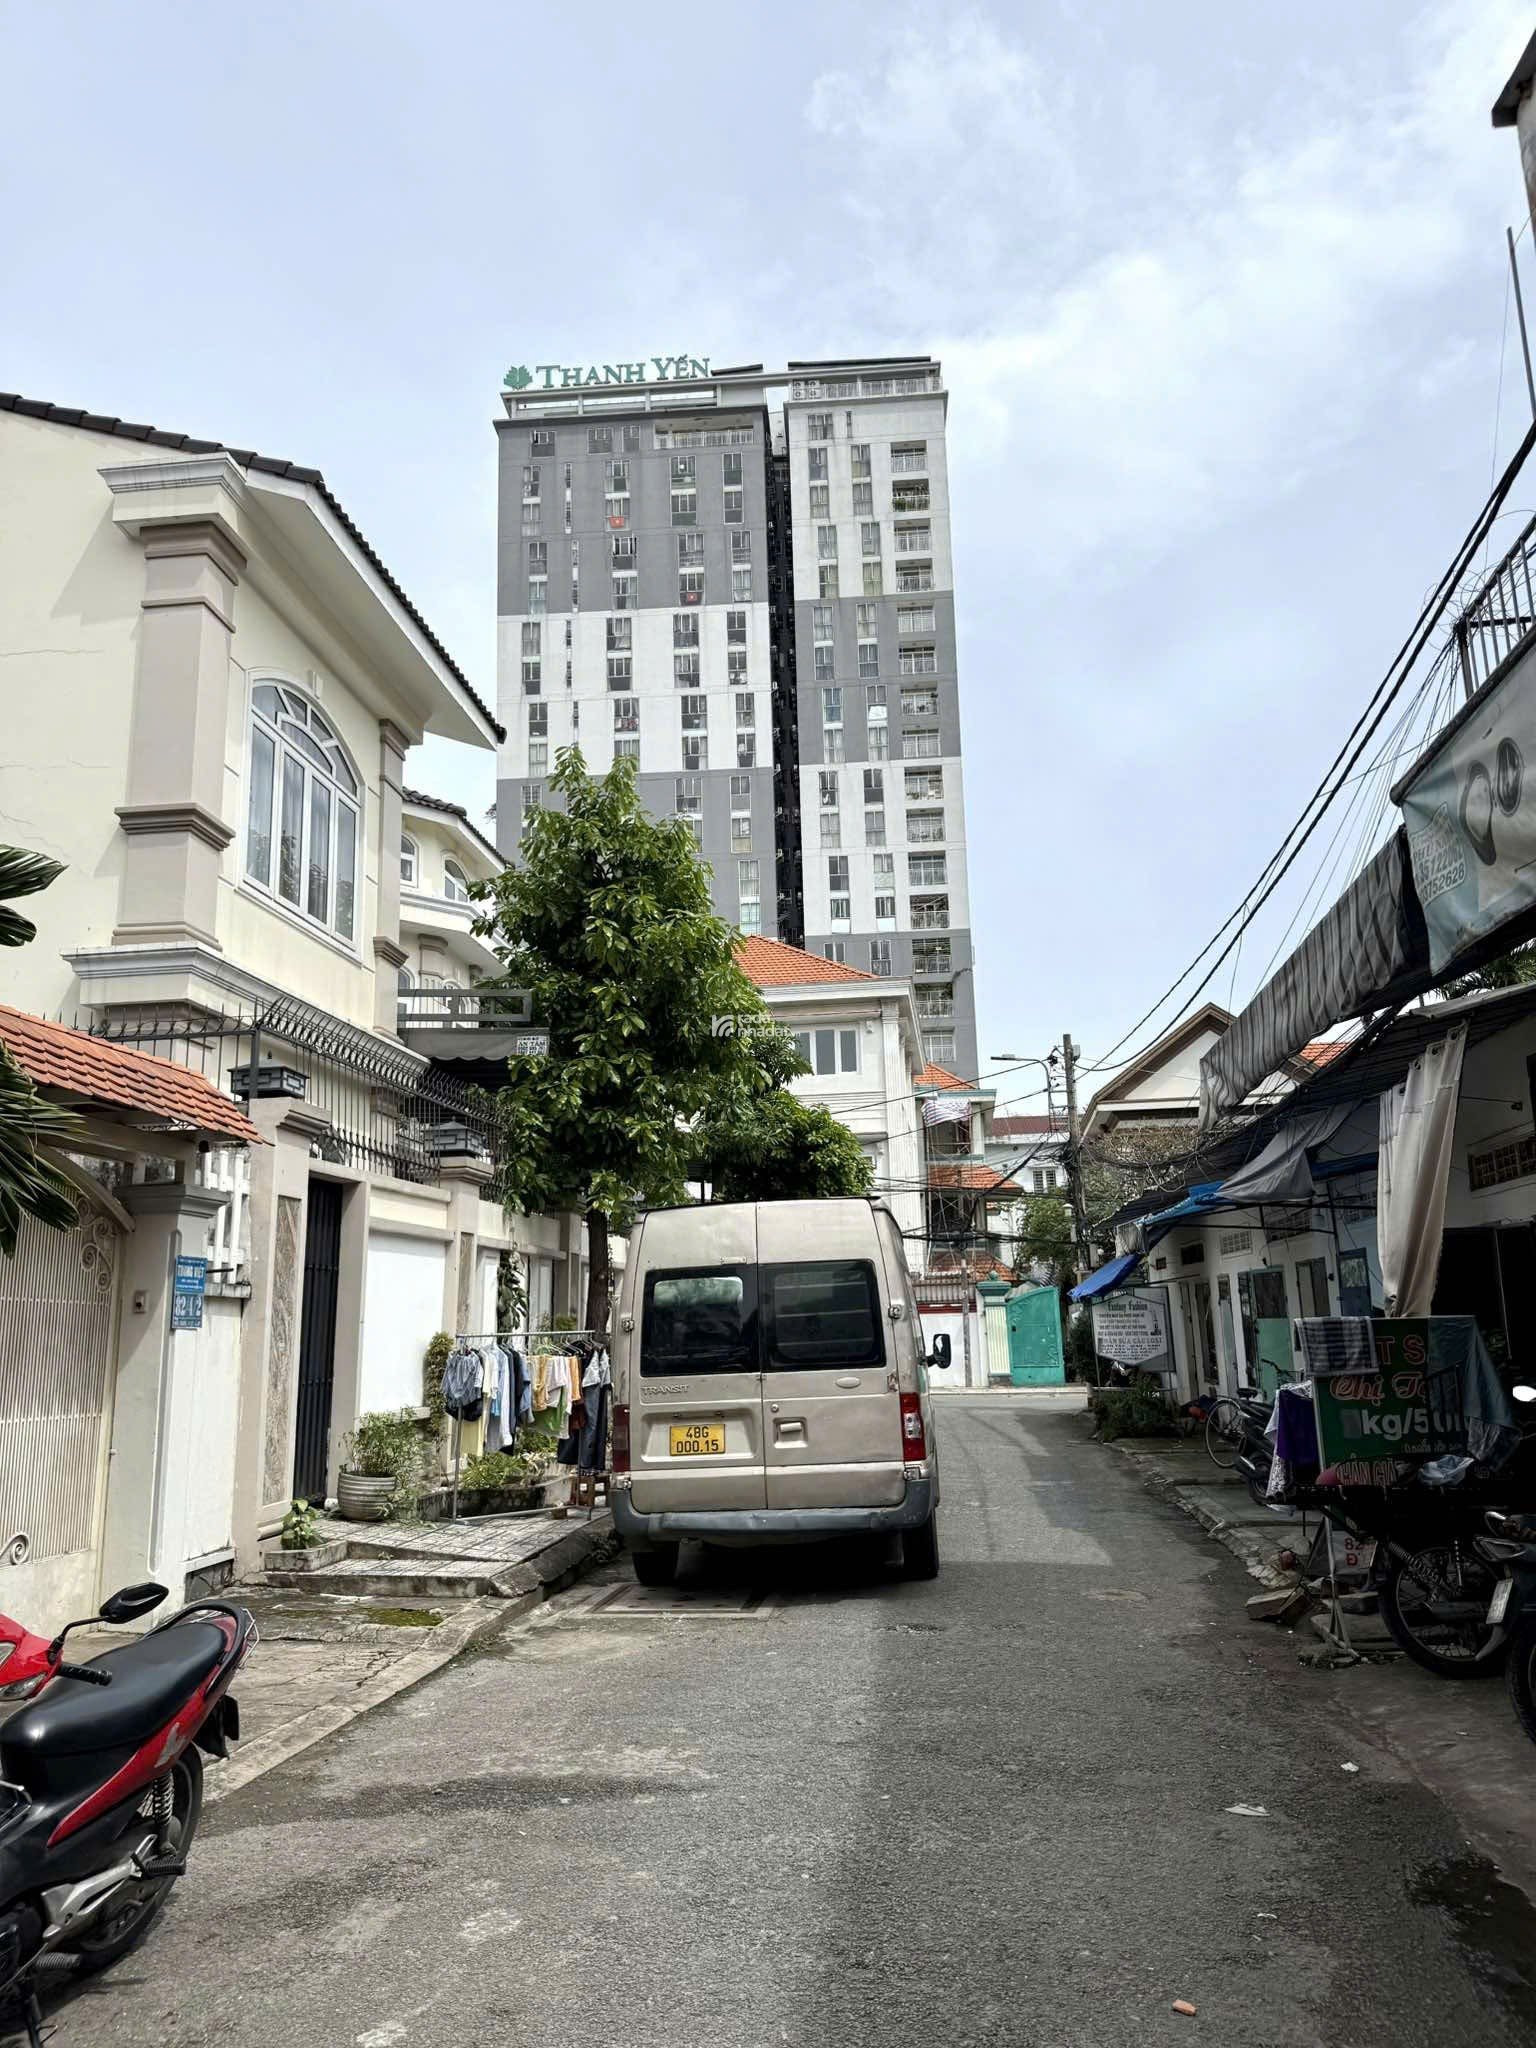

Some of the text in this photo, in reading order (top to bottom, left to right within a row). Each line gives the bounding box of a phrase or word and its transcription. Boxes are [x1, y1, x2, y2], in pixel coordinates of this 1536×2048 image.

[535, 354, 711, 389] THANH YẾN
[640, 1384, 689, 1396] TRANSIT
[676, 1439, 719, 1453] 000.15
